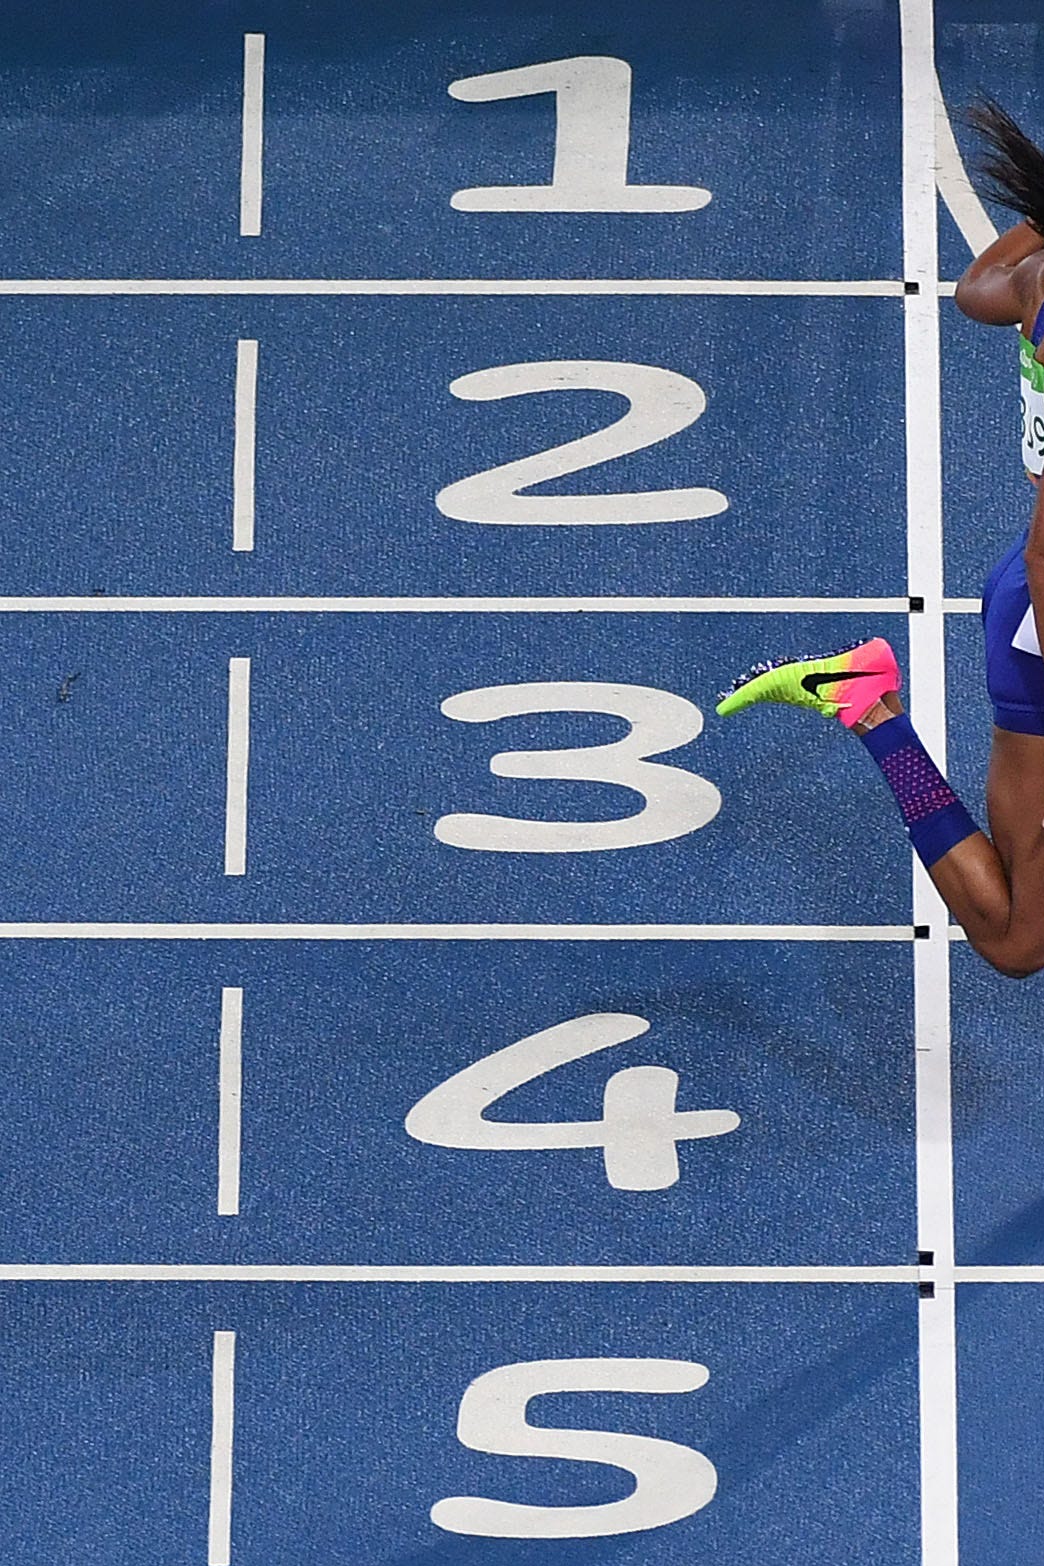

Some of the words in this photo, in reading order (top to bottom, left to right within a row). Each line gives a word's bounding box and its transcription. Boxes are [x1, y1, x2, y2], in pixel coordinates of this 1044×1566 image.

[448, 57, 712, 212] 1
[435, 360, 728, 525] 2
[434, 682, 721, 853] 3
[405, 1013, 740, 1191] 4
[430, 1357, 717, 1538] 5
